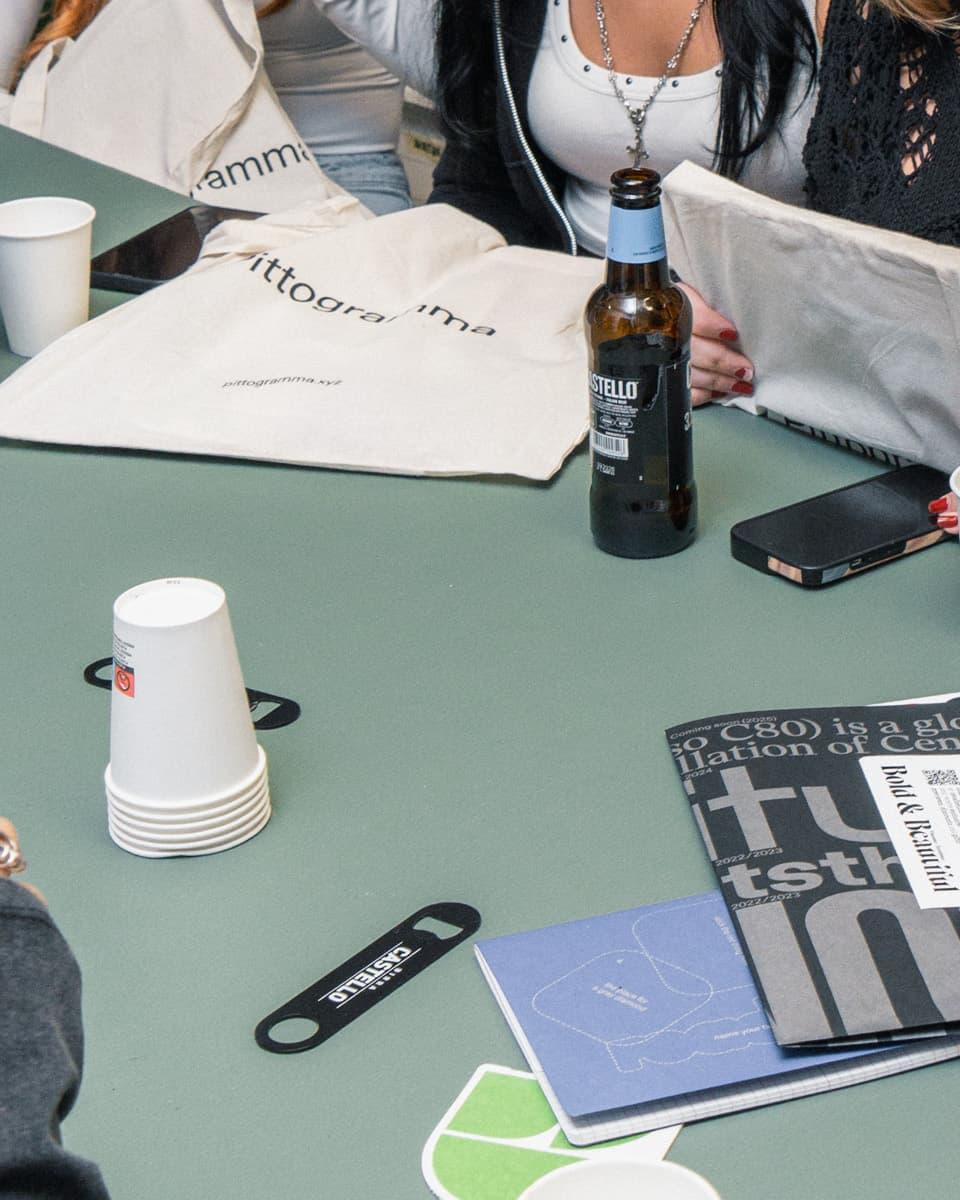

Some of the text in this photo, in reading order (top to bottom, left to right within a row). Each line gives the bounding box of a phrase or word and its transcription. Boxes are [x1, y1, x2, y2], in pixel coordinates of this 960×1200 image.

[222, 374, 344, 389] pittogramma.xyz
[670, 723, 713, 740] Coming
[720, 718, 822, 742] C80)
[832, 717, 868, 736] is
[878, 719, 903, 735] a
[827, 734, 869, 756] of
[880, 765, 918, 799] Bold
[896, 801, 925, 816] &
[714, 847, 784, 868] 2022/2023
[903, 818, 960, 893] Beautiful
[730, 891, 802, 911] 2022/2023
[328, 946, 412, 1004] CASTELLO
